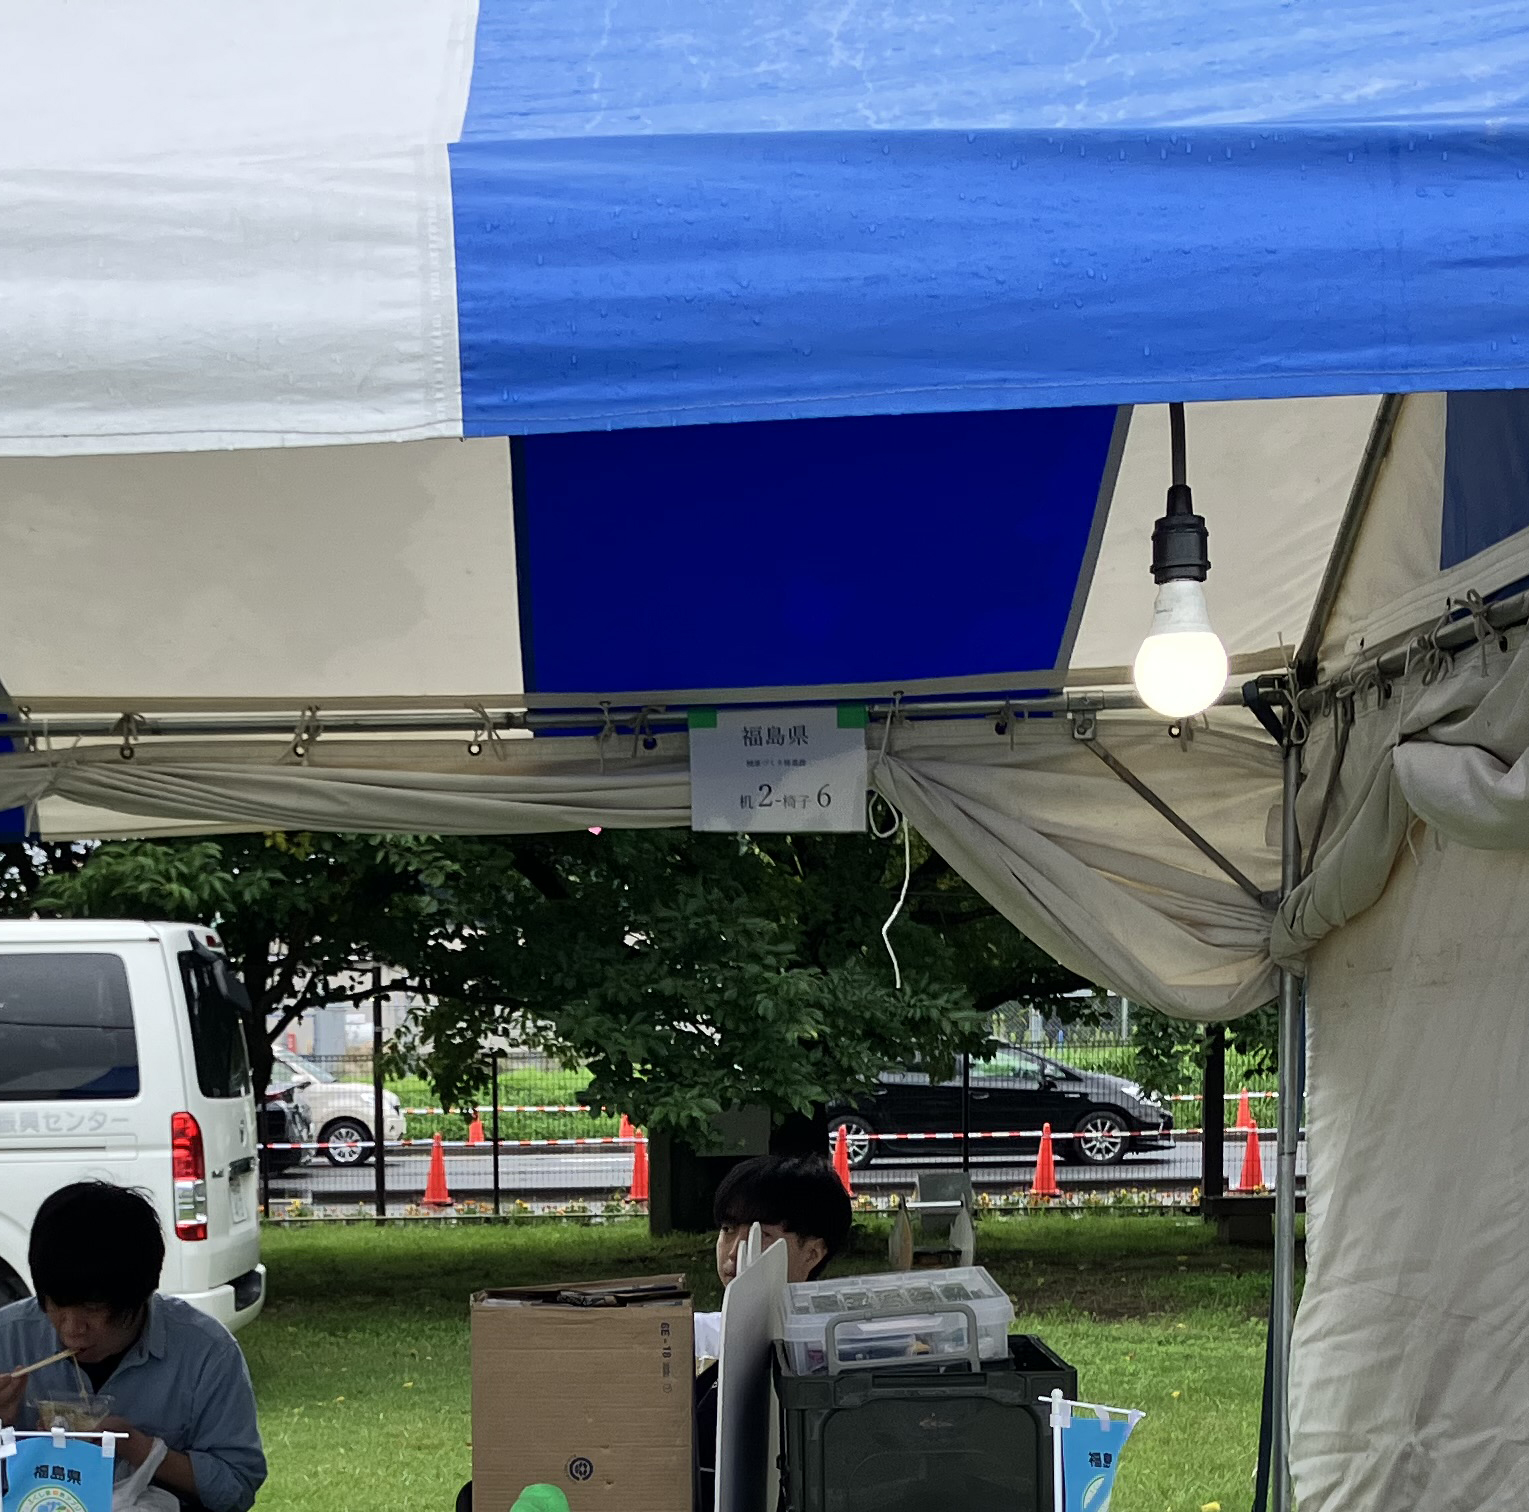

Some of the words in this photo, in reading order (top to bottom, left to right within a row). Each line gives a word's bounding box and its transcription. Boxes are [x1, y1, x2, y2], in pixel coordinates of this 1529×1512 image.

[742, 725, 808, 746] 福島県
[33, 1464, 82, 1485] 福島県
